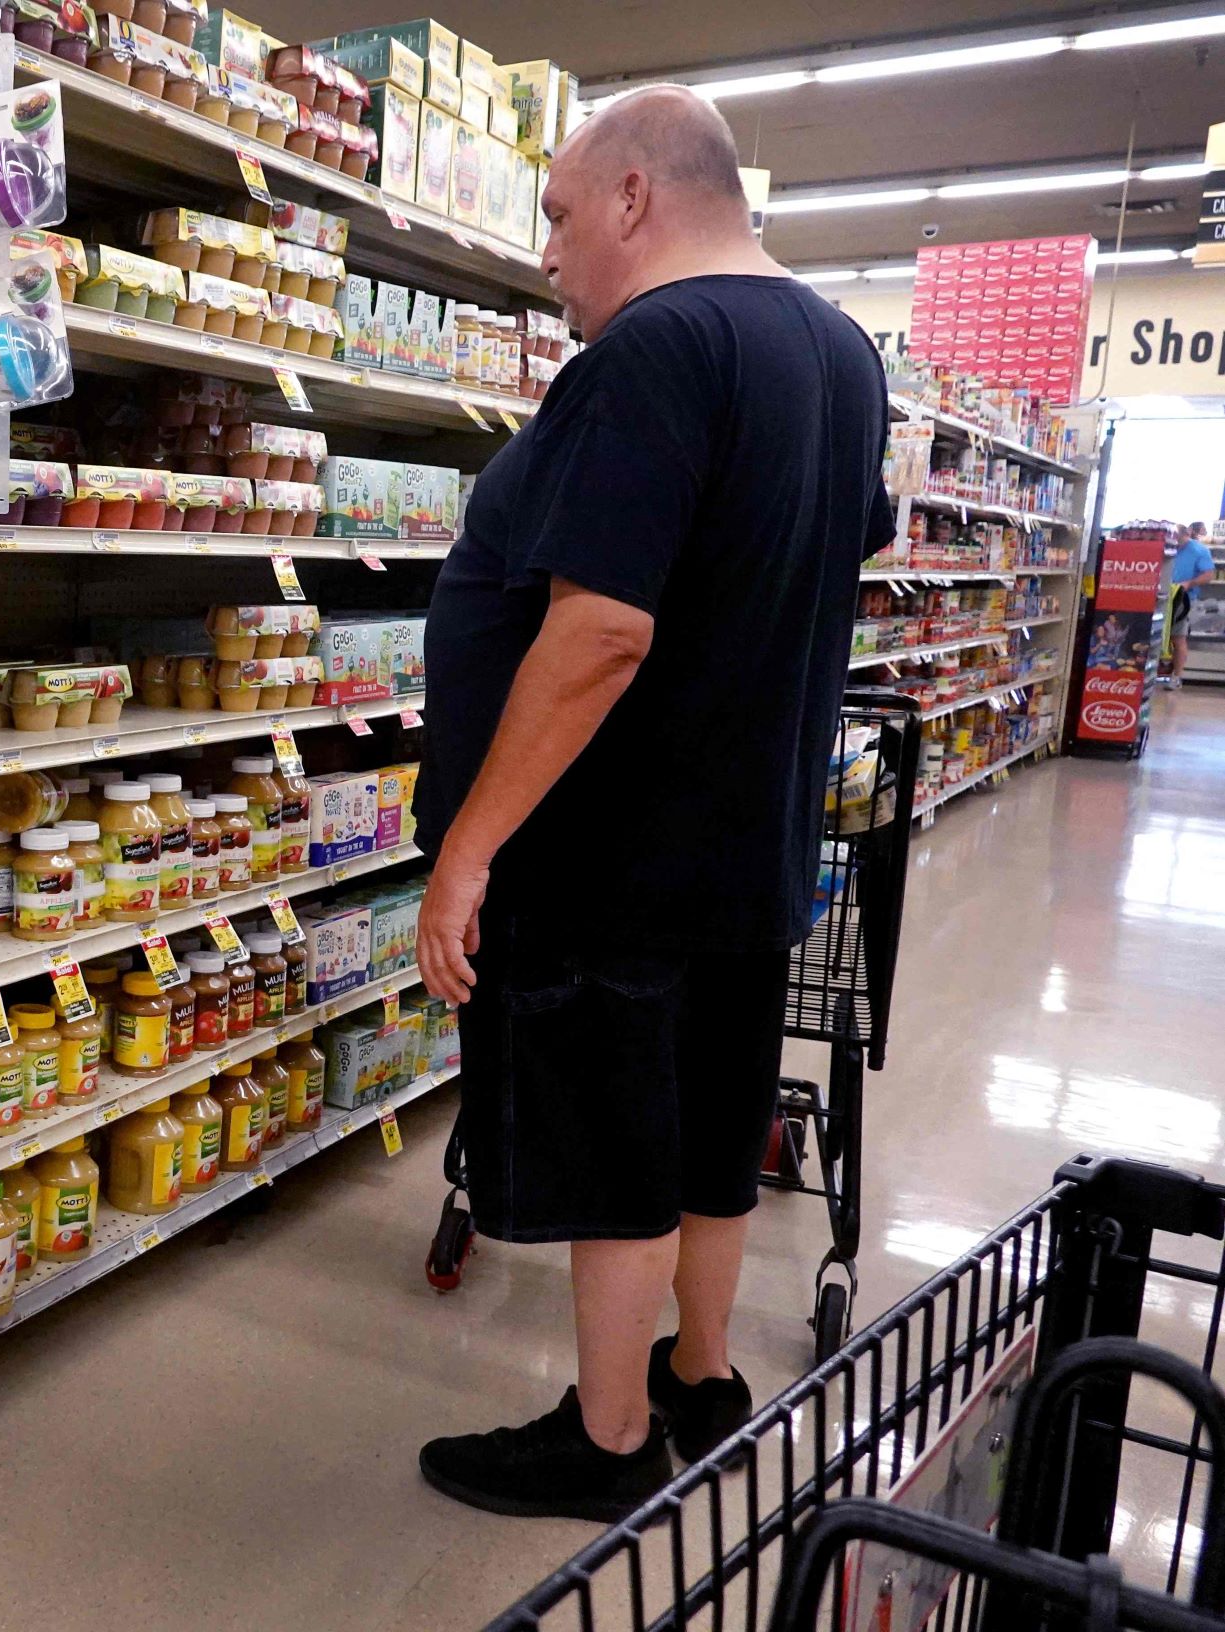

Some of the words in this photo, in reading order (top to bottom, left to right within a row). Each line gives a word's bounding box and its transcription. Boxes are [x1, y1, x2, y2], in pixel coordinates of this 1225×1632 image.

[1103, 560, 1158, 573] ENJOY
[1091, 706, 1128, 720] Jewel
[1090, 716, 1126, 727] Osco
